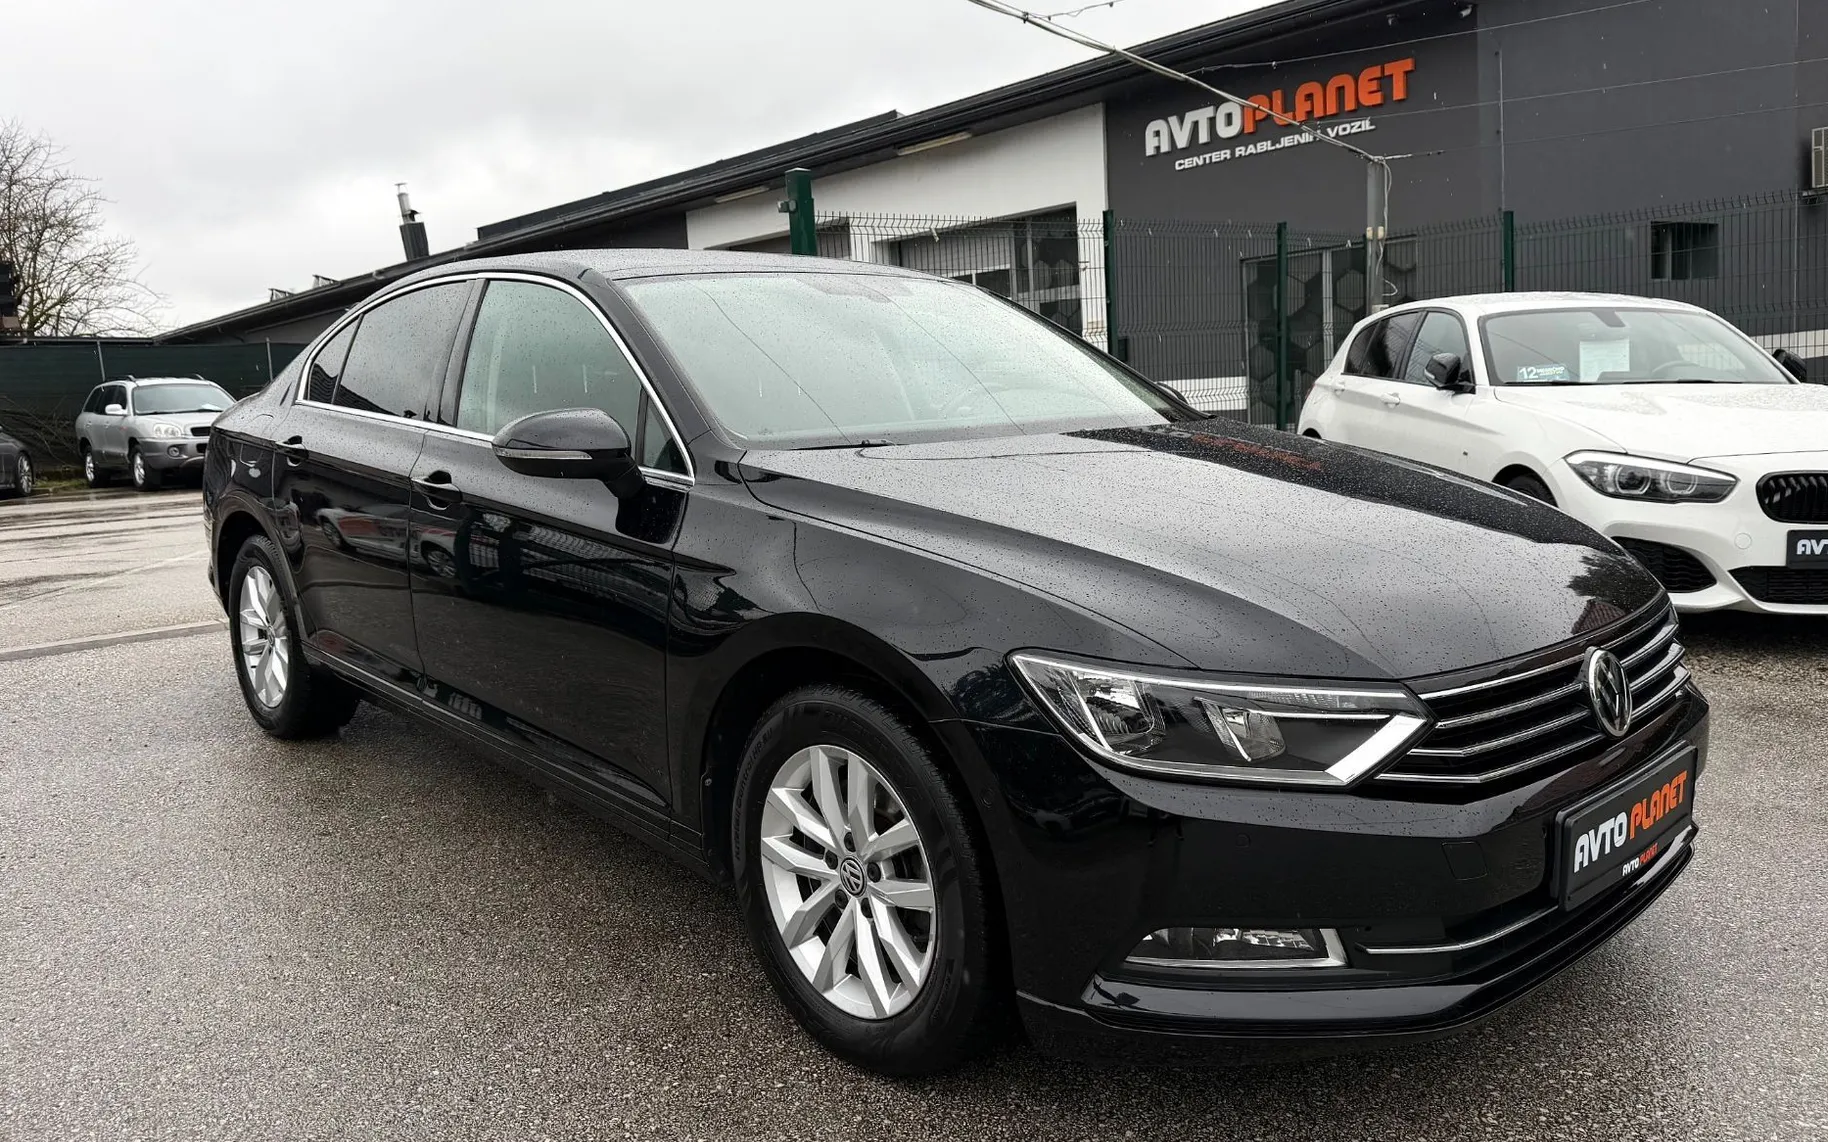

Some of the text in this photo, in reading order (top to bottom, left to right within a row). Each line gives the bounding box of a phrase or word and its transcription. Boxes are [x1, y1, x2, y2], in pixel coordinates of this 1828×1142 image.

[1174, 150, 1231, 171] CENTER
[1326, 118, 1376, 138] VOZIL
[1519, 366, 1539, 379] 12
